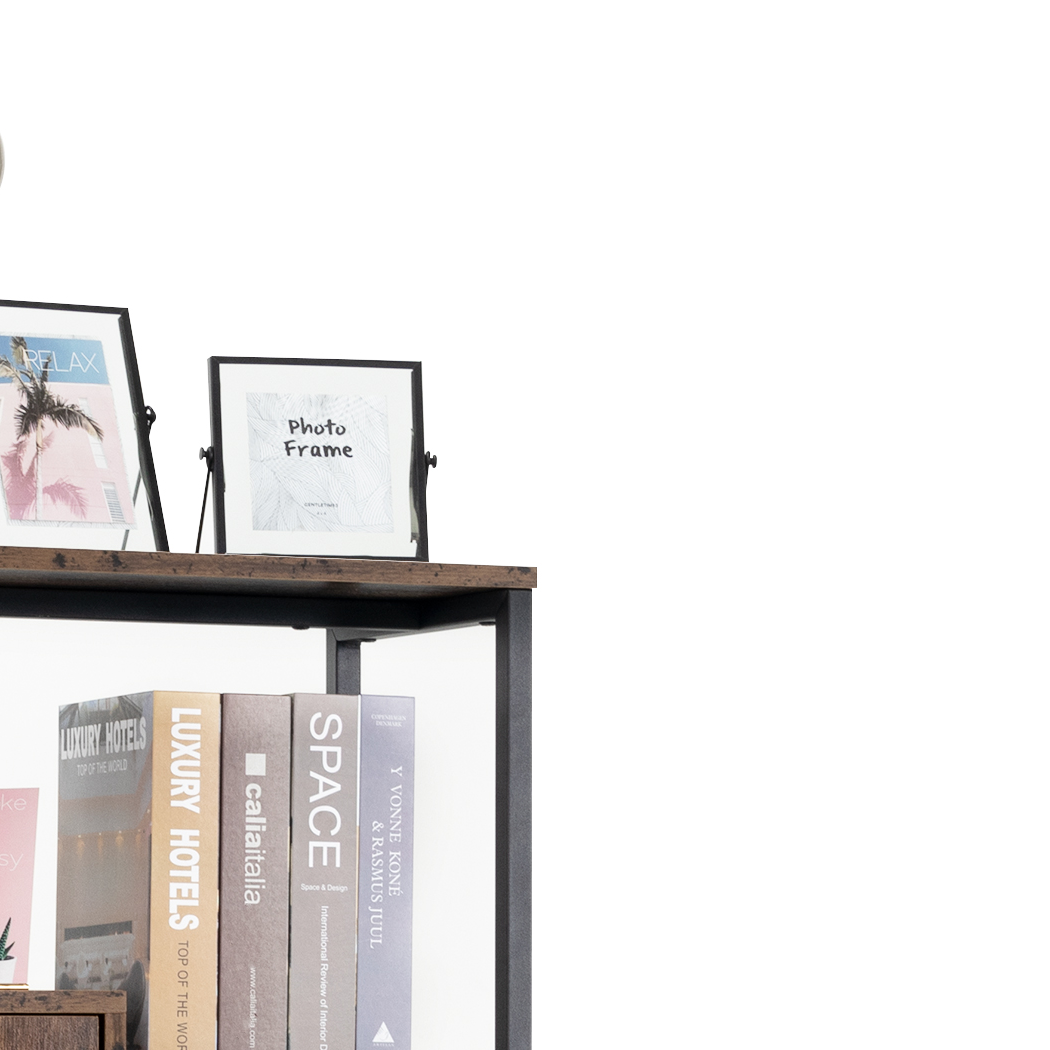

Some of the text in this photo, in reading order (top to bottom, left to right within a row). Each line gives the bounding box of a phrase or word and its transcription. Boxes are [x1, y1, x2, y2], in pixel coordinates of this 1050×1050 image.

[23, 349, 100, 374] RELAX
[288, 417, 347, 436] Photo
[283, 440, 354, 458] Frame
[60, 716, 147, 761] LUXURY HOTELS
[77, 759, 128, 777] TOP OF THE WORLD
[308, 711, 343, 868] SPACE
[168, 707, 202, 931] LUXURY HOTELS
[244, 782, 267, 906] caliaitalia
[300, 883, 320, 892] Space
[327, 884, 348, 893] Design
[369, 820, 385, 949] & RASMUS JUUL
[388, 850, 404, 897] KONÉ
[320, 905, 329, 962] International
[177, 940, 189, 967] TOP
[177, 969, 189, 988] OF
[320, 963, 329, 997] Review
[176, 992, 189, 1018] THE
[319, 998, 328, 1009] of
[319, 1010, 328, 1042] Interior
